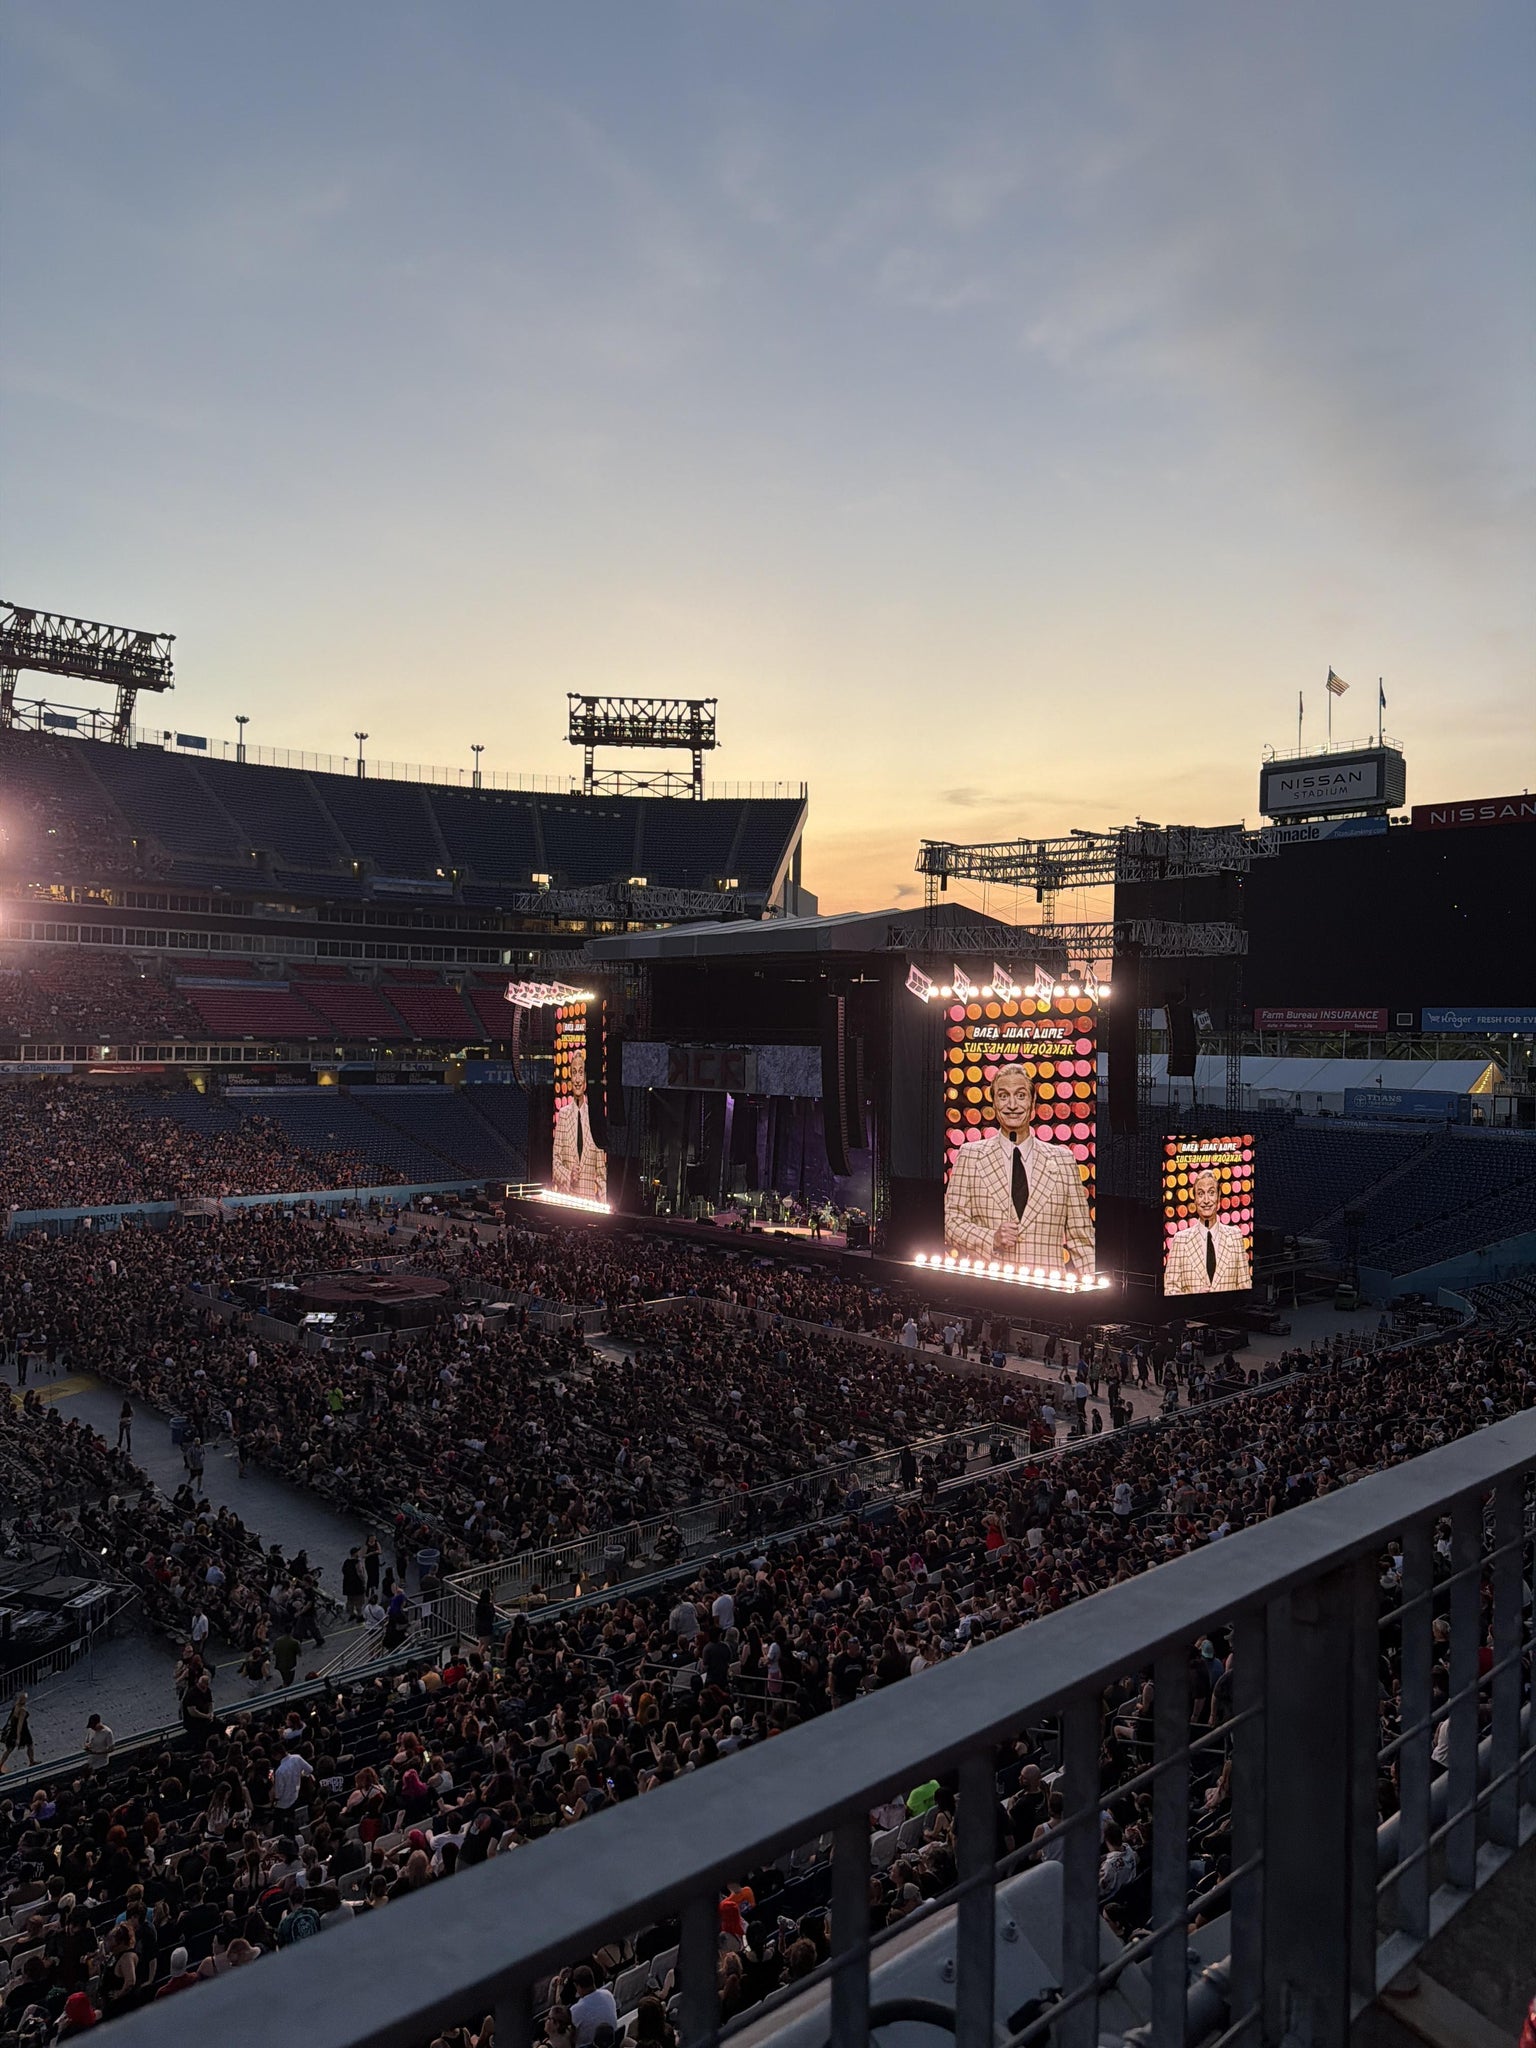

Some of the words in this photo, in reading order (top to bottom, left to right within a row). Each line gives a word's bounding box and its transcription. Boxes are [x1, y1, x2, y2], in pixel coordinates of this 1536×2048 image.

[1281, 771, 1362, 790] NISSAN
[1293, 786, 1348, 799] STADIUM
[1430, 803, 1536, 825] NISSAN
[1261, 1010, 1284, 1019] Farm
[1286, 1010, 1318, 1019] Bureau
[1320, 1010, 1379, 1019] INSURANCE
[1441, 1011, 1472, 1028] Kroger
[1477, 1016, 1502, 1024] FRESH
[1504, 1016, 1521, 1024] FOR
[1367, 1094, 1402, 1103] TITANS
